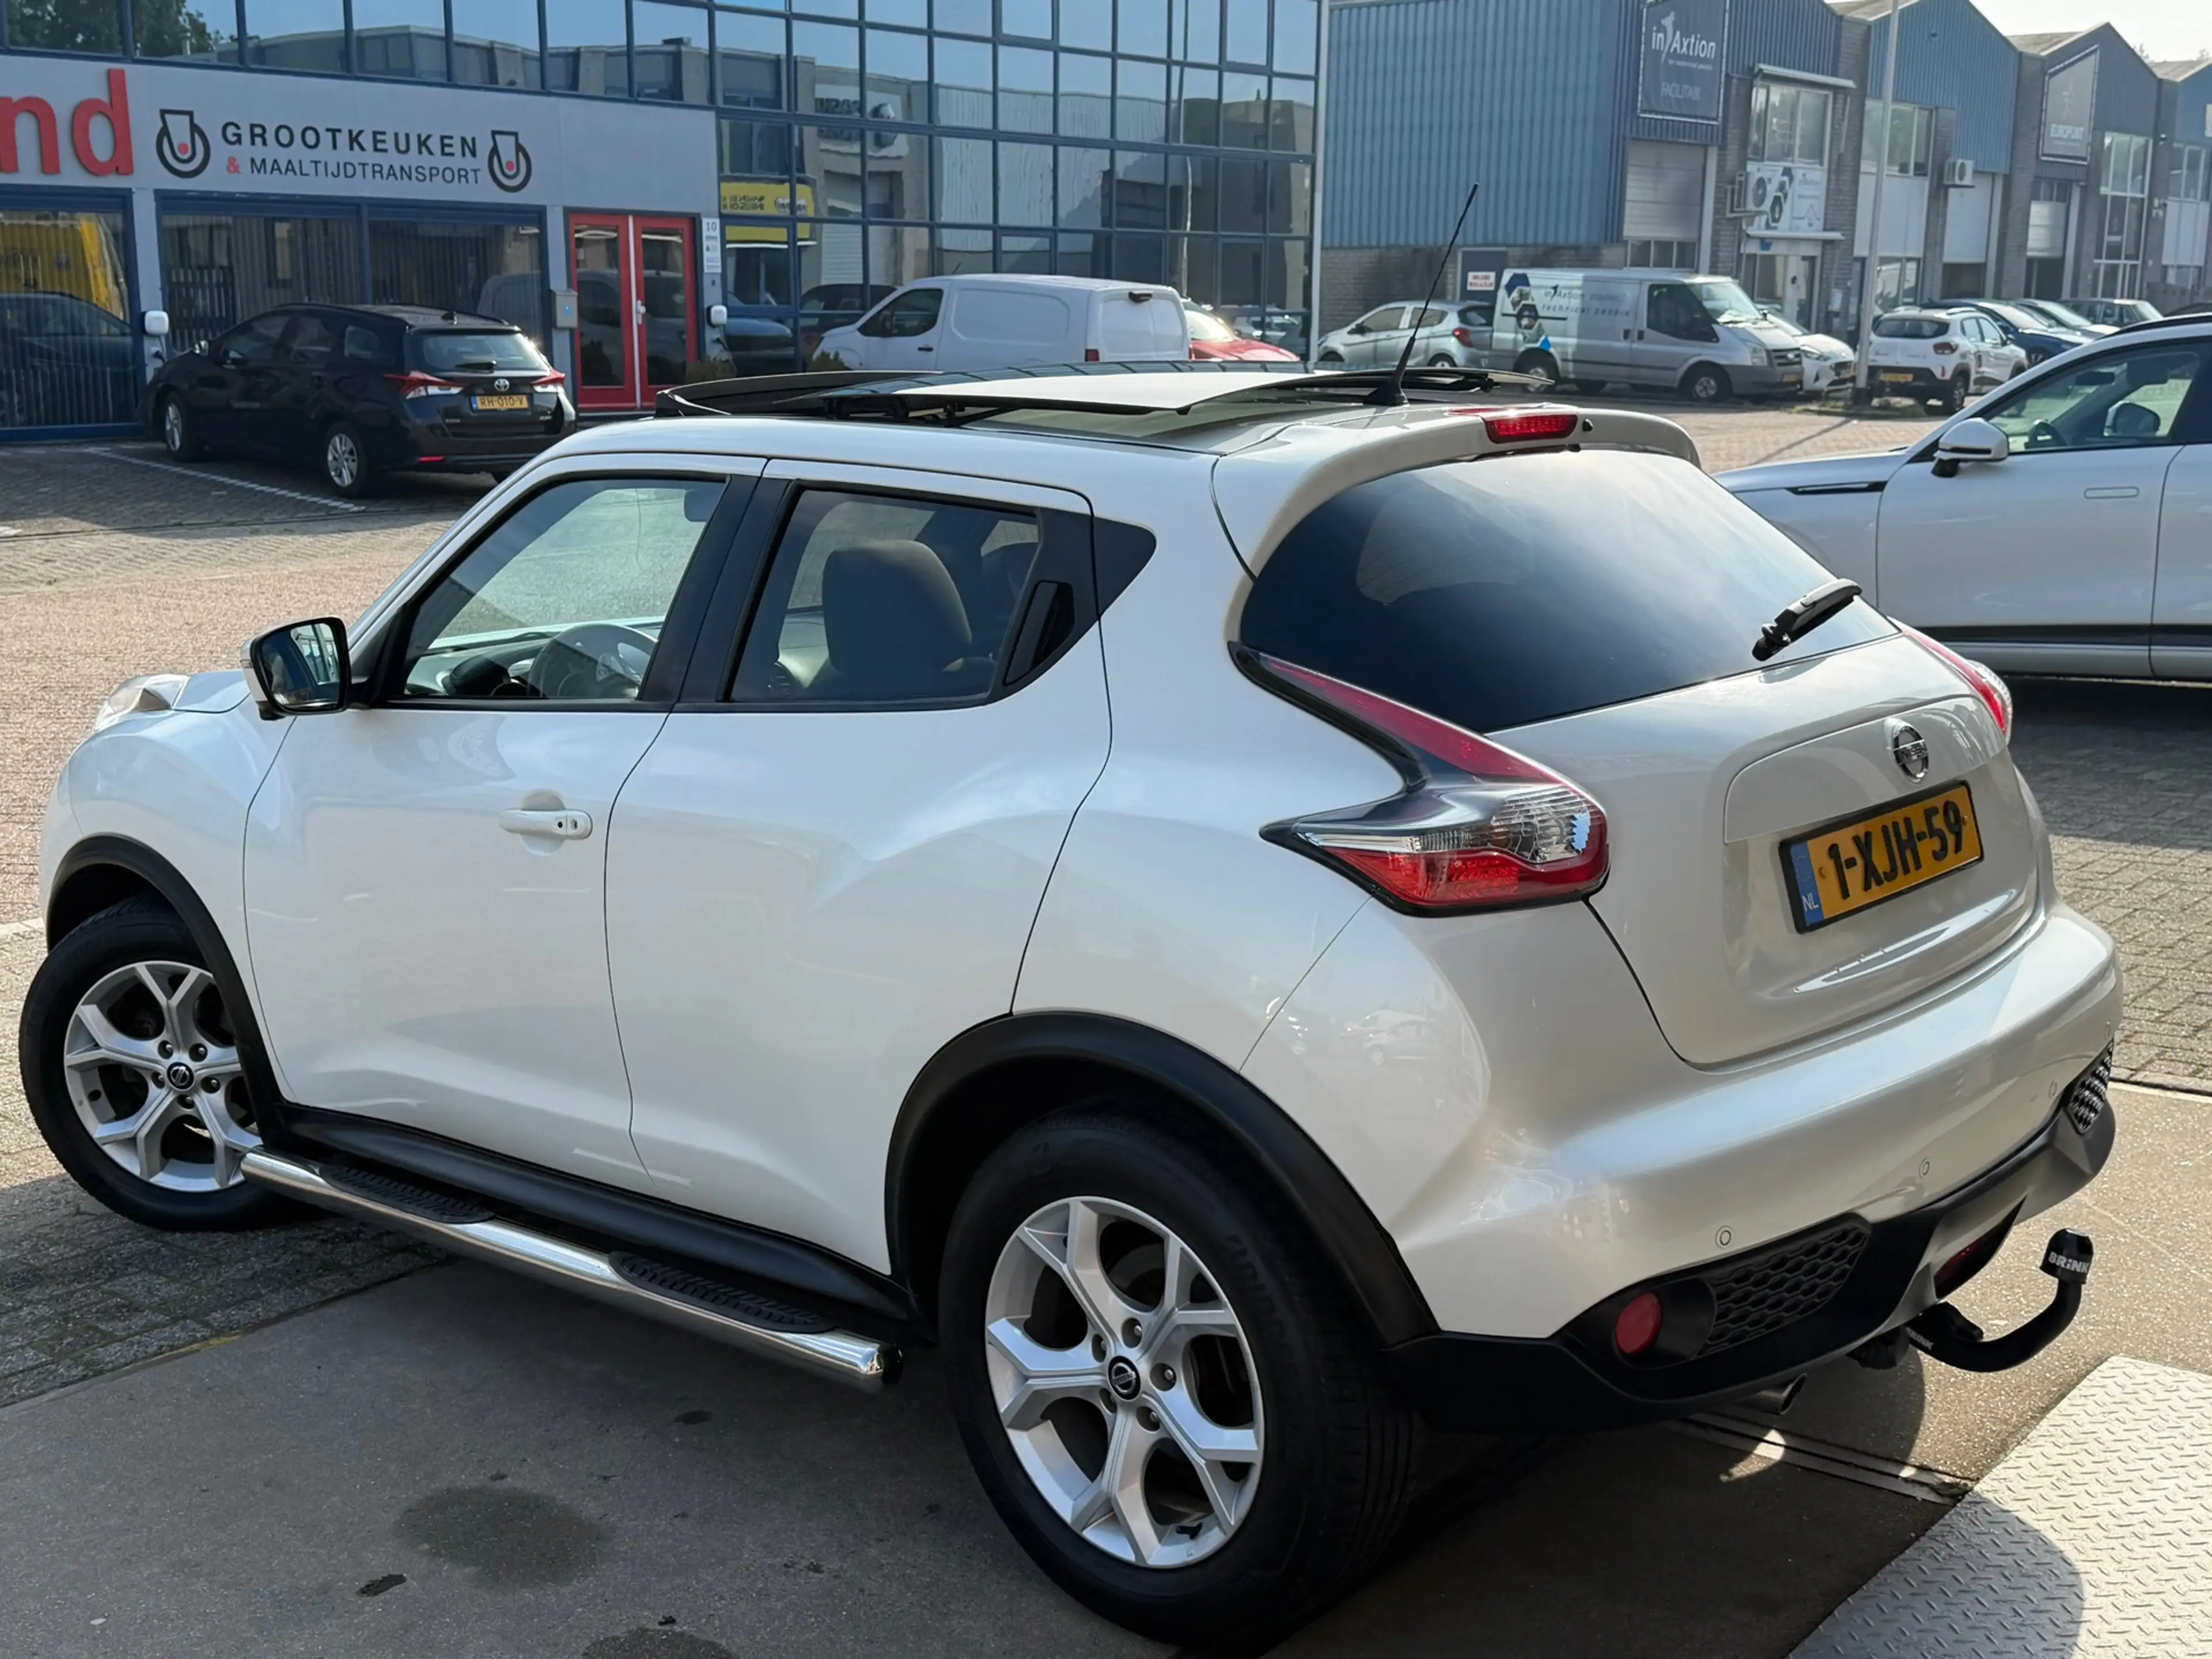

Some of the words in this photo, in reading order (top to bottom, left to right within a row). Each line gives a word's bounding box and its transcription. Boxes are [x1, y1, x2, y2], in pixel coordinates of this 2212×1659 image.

[221, 122, 478, 158] GROOTKEUKEN
[226, 157, 241, 174] &
[250, 157, 482, 184] MAALTIJDTRANSPORT
[706, 221, 717, 232] 10
[1828, 800, 1964, 901] 1-XJH-59
[1801, 895, 1820, 912] NL
